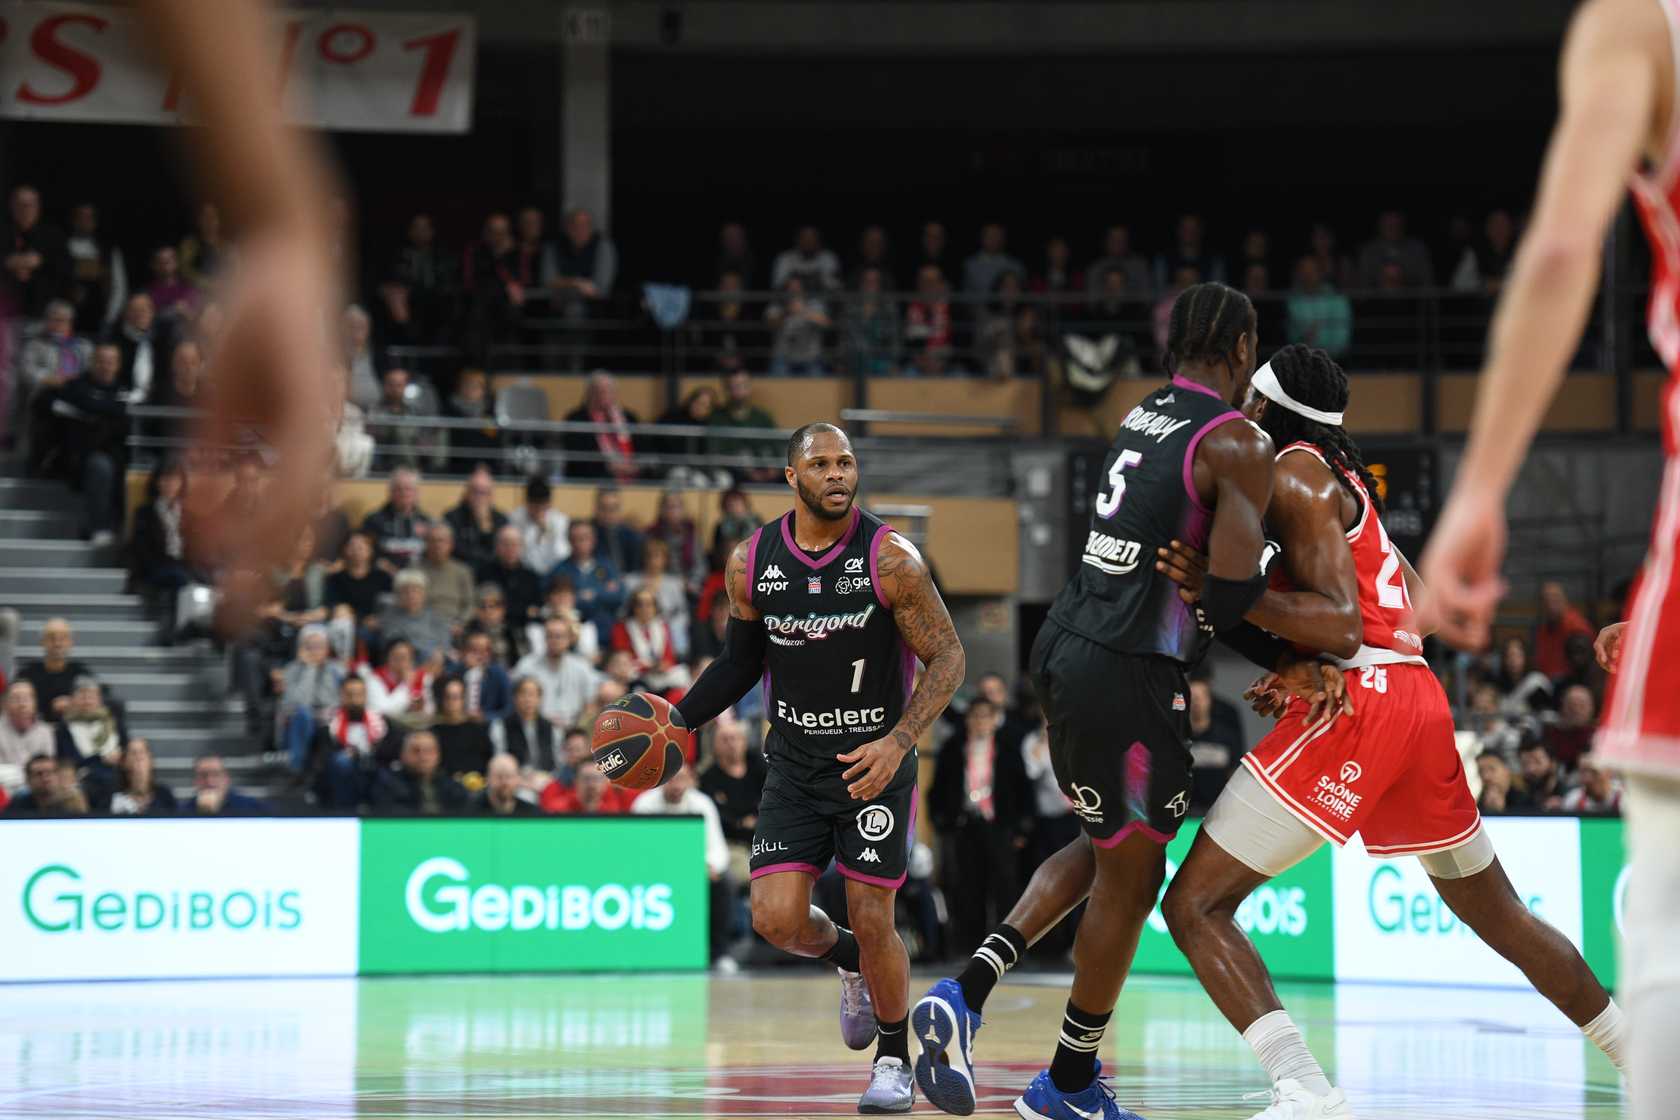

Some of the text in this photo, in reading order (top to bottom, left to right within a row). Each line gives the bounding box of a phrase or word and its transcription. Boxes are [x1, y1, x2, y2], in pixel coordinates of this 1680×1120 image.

[1096, 449, 1142, 519] 5
[757, 580, 789, 595] ayor
[764, 604, 875, 638] Périgord
[851, 658, 865, 693] 1
[1360, 665, 1388, 694] 25
[777, 700, 885, 728] E.Leclerc
[1316, 790, 1356, 818] LOIRE
[1317, 775, 1363, 807] SAÔNE
